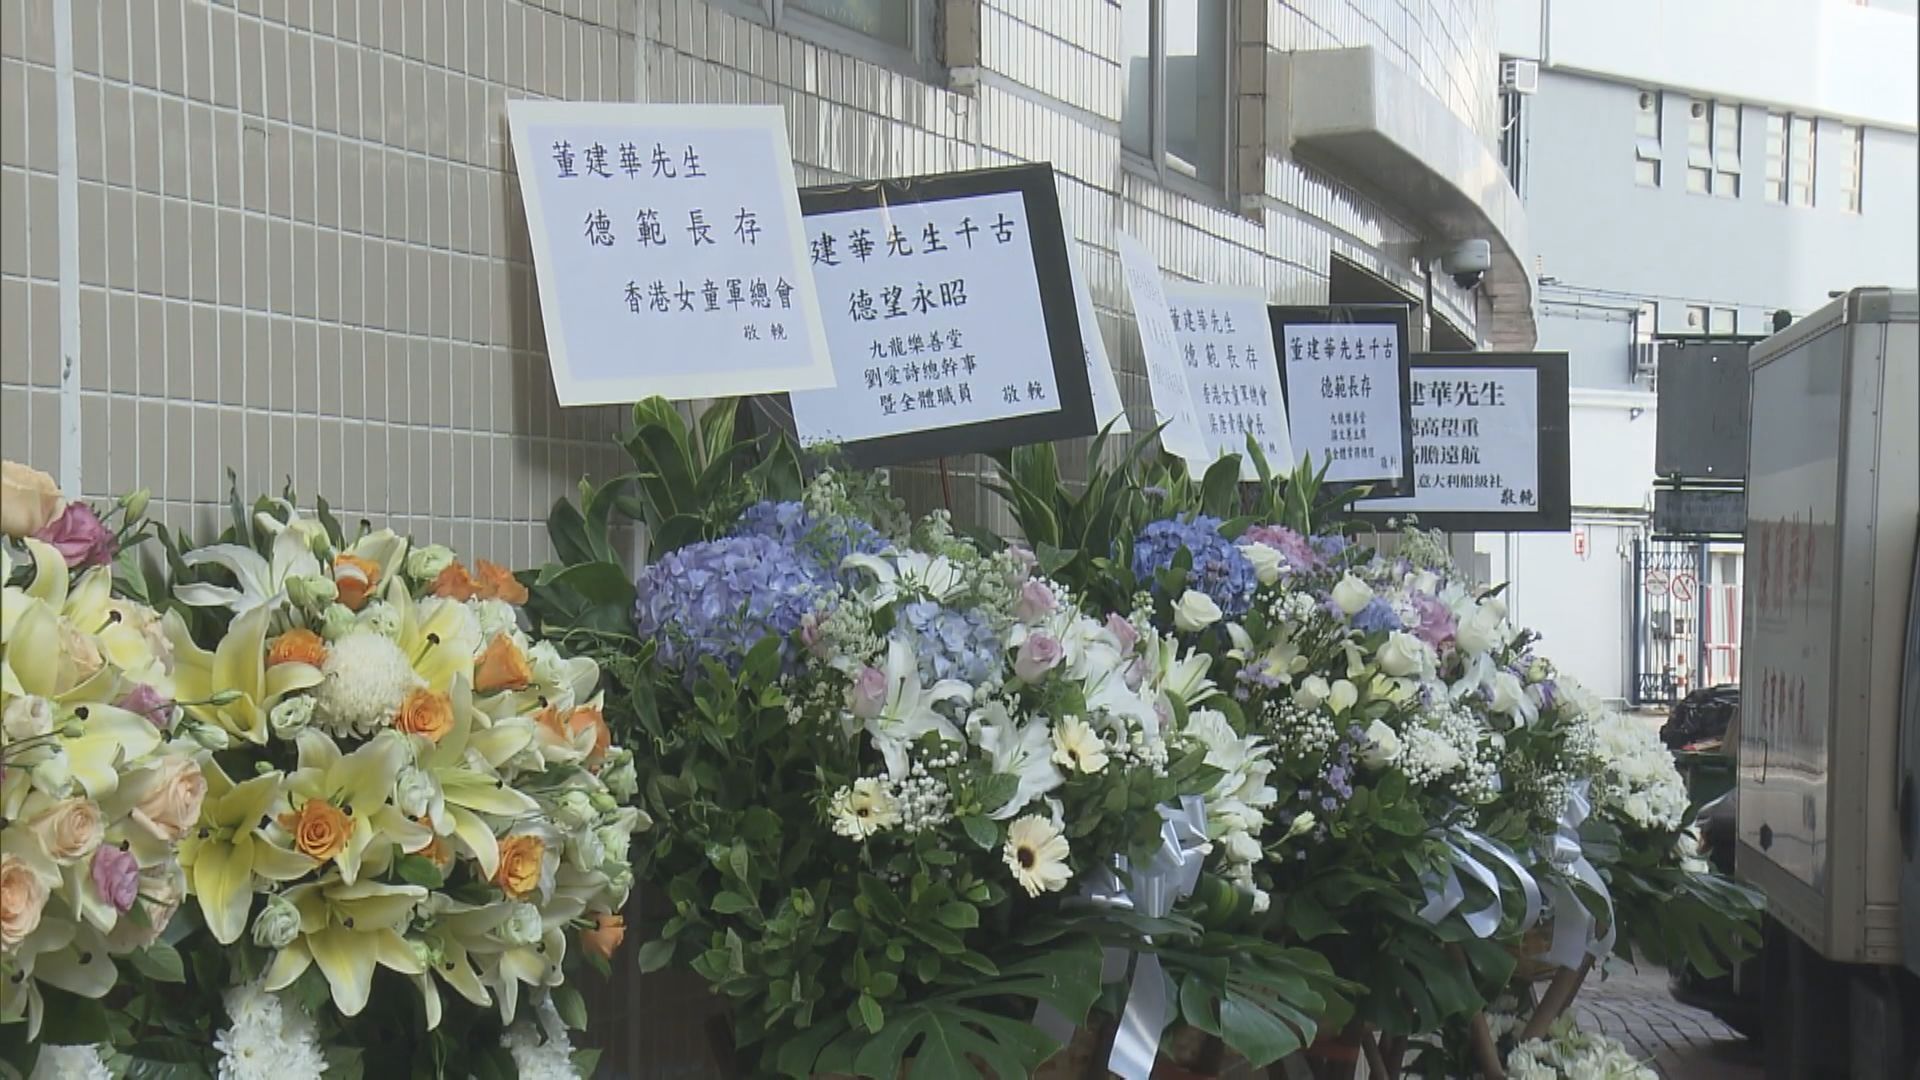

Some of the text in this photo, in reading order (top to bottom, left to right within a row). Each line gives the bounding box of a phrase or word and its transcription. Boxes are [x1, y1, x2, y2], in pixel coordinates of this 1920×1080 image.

[552, 140, 707, 180] 董建華先生
[584, 207, 762, 247] 德範長存
[624, 276, 795, 313] 香港女童軍總會
[848, 278, 968, 322] 德望永昭
[1169, 305, 1236, 334] 董建華先生
[869, 328, 963, 359] 九龍樂善堂
[1290, 336, 1393, 361] 董建華先生千古
[864, 353, 977, 390] 劉愛詩總幹事
[1321, 372, 1372, 399] 德範長存
[879, 382, 972, 416] 暨全體職員
[1417, 473, 1504, 488] 意大利船級社
